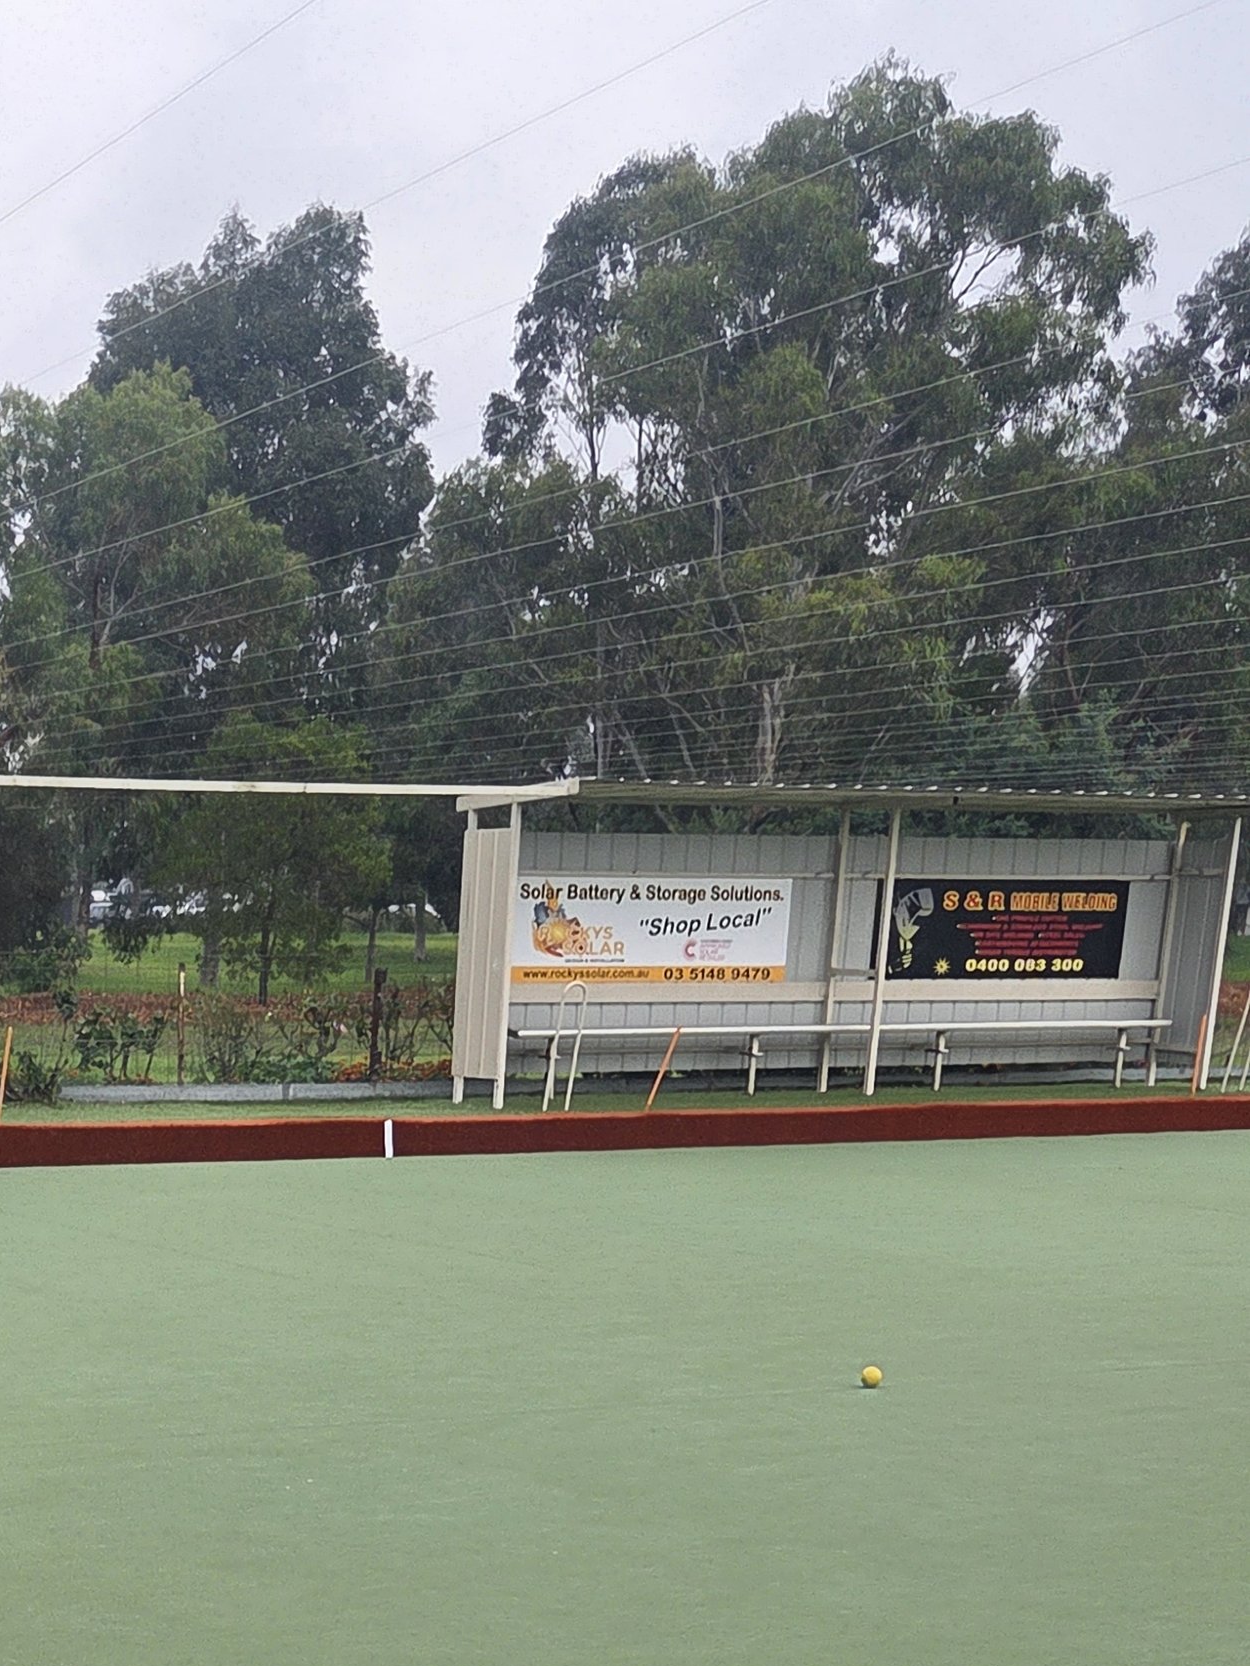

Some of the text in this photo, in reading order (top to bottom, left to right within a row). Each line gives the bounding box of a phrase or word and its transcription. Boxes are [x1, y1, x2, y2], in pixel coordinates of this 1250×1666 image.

[520, 882, 784, 905] Solar Battery & Storage Solutions.
[943, 890, 1117, 912] S & R MOBILE WELDING
[640, 907, 772, 937] "Shop Local"
[562, 941, 625, 956] SOLAR
[965, 958, 1010, 972] 0400
[1051, 958, 1084, 972] 300
[522, 968, 650, 981] www.rockyssolar.com.au
[663, 967, 771, 981] 03 5148 9479
